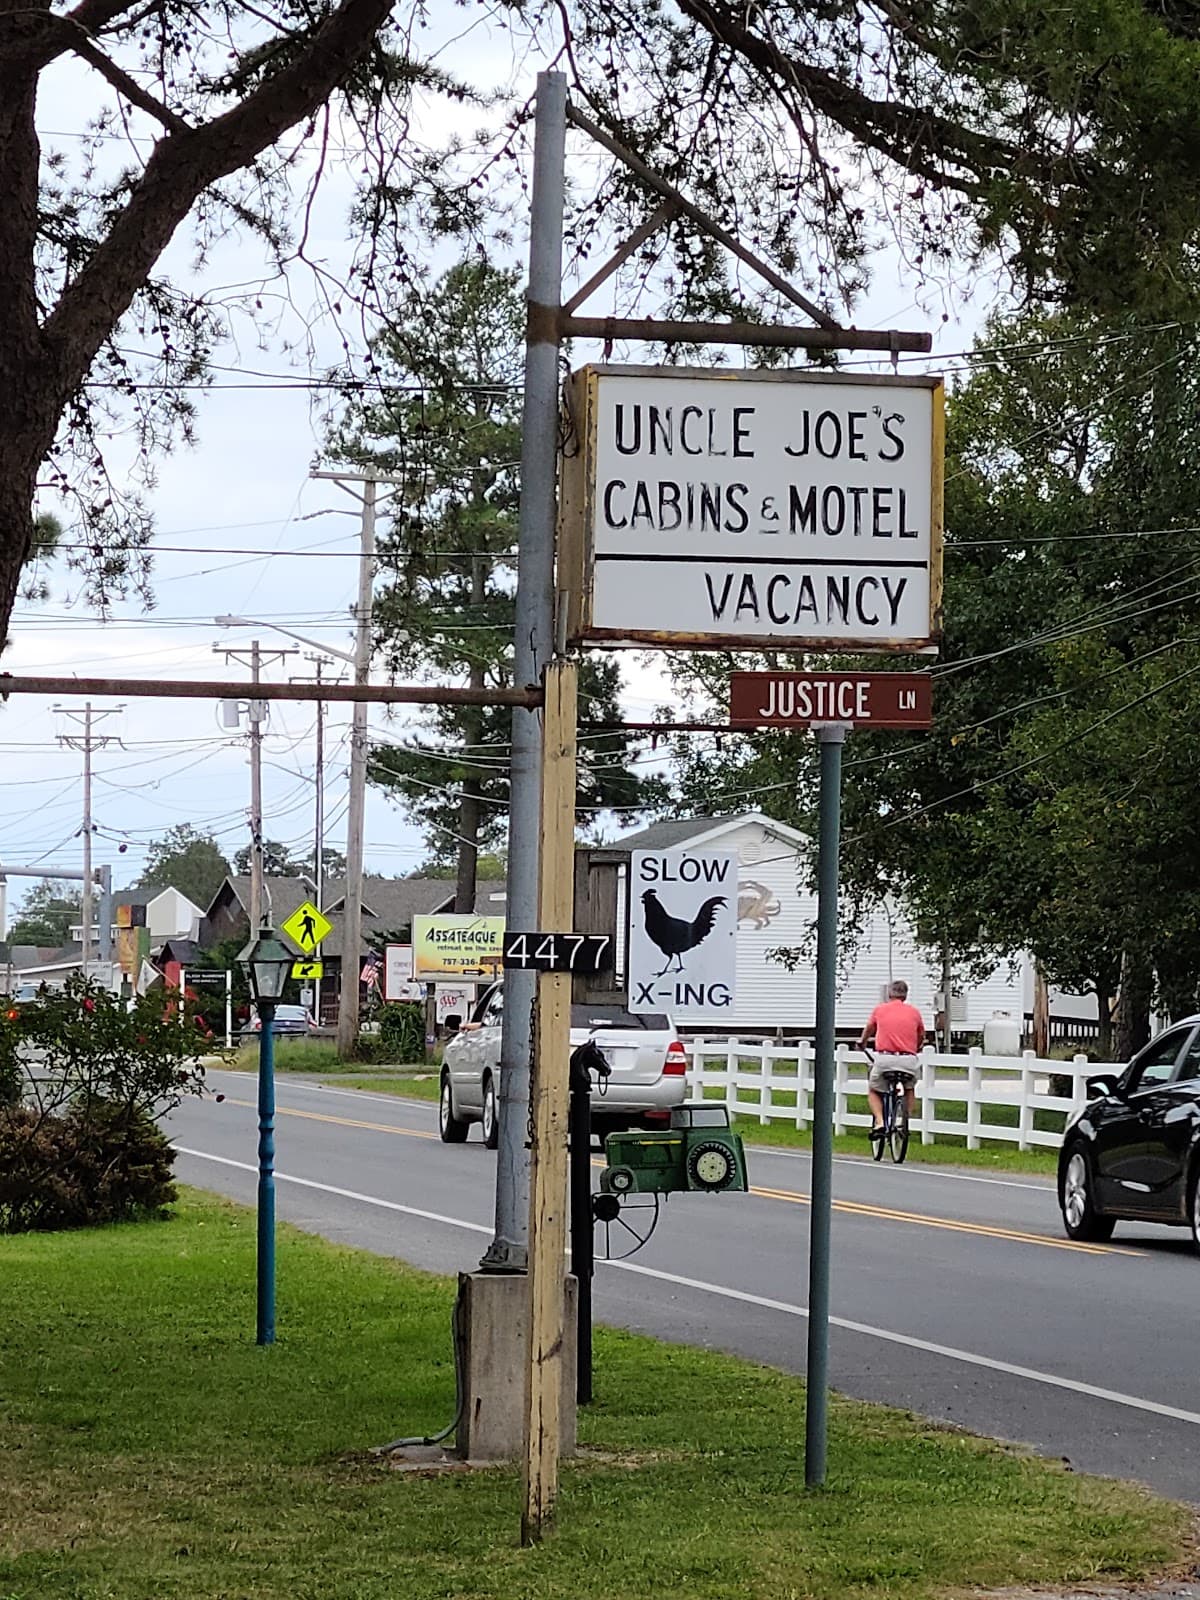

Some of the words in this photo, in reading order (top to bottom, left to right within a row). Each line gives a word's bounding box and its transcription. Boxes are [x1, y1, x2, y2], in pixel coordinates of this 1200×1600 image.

[615, 404, 755, 458] UNCLE
[785, 405, 905, 462] JOE'S
[603, 480, 749, 534] CABINS
[759, 496, 780, 535] &
[789, 485, 918, 539] MOTEL
[704, 572, 907, 626] VACANCY
[759, 680, 871, 718] JUSTICE
[898, 689, 916, 710] LN
[639, 857, 730, 883] SLOW
[426, 927, 496, 943] ASSATEAGUE
[506, 934, 610, 969] 4477
[635, 982, 730, 1007] X-ING
